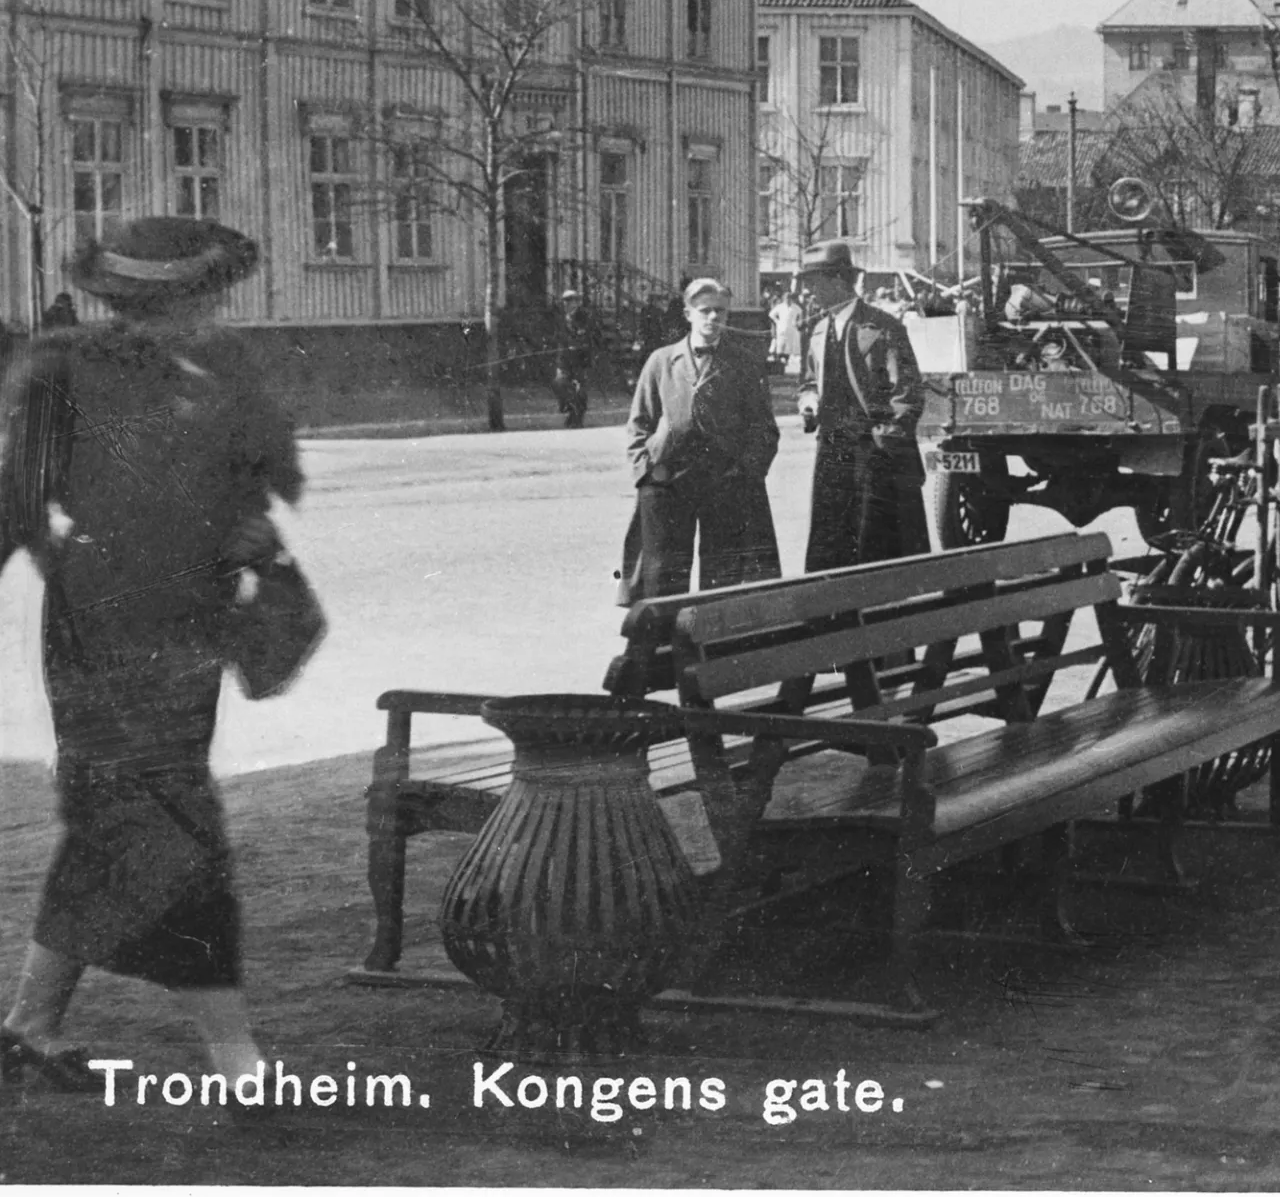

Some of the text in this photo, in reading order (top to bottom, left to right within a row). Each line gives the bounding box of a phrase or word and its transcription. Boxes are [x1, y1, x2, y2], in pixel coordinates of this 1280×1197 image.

[955, 379, 1003, 395] TELEFON
[1009, 374, 1047, 391] DAG
[963, 395, 1001, 416] 768
[1041, 402, 1073, 420] NAT
[1080, 394, 1117, 415] 768
